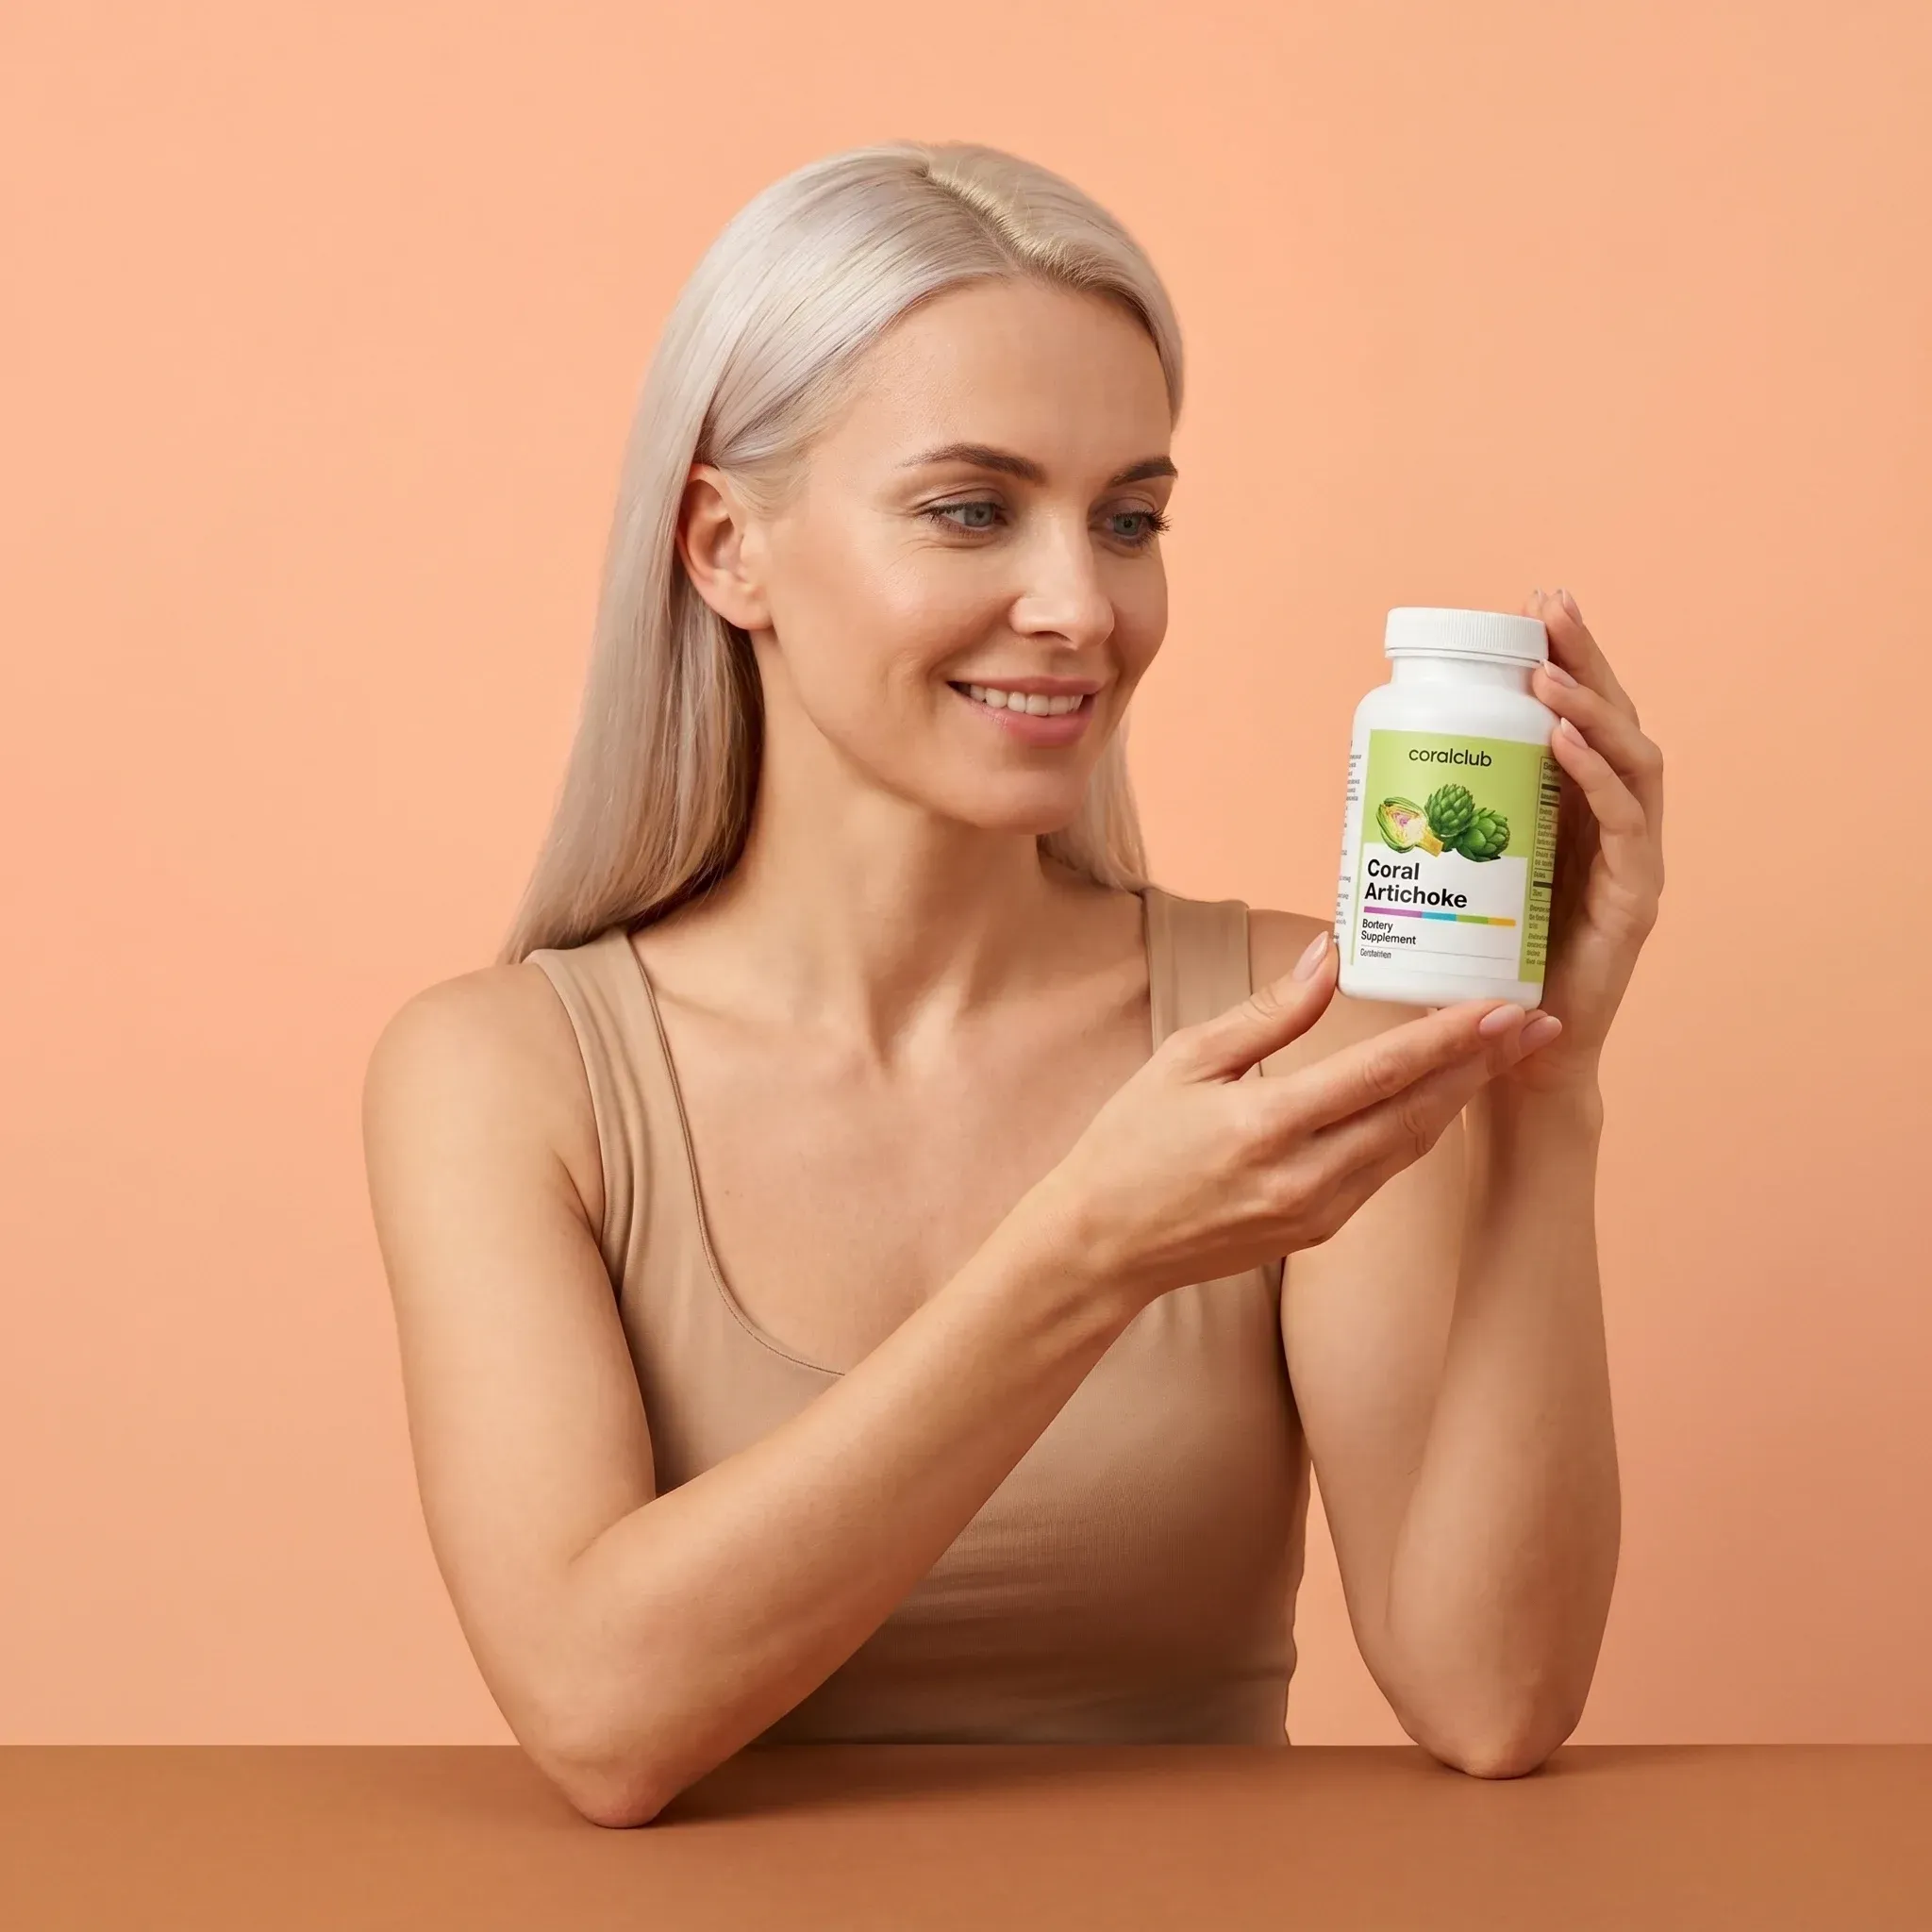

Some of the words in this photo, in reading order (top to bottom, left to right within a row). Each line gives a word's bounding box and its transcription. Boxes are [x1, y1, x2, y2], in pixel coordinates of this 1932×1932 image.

[1408, 748, 1492, 767] coralclub
[1367, 858, 1420, 880] Coral
[1364, 882, 1468, 908] Artichoke
[1362, 918, 1393, 933] Bortery
[1360, 930, 1417, 945] Supplement
